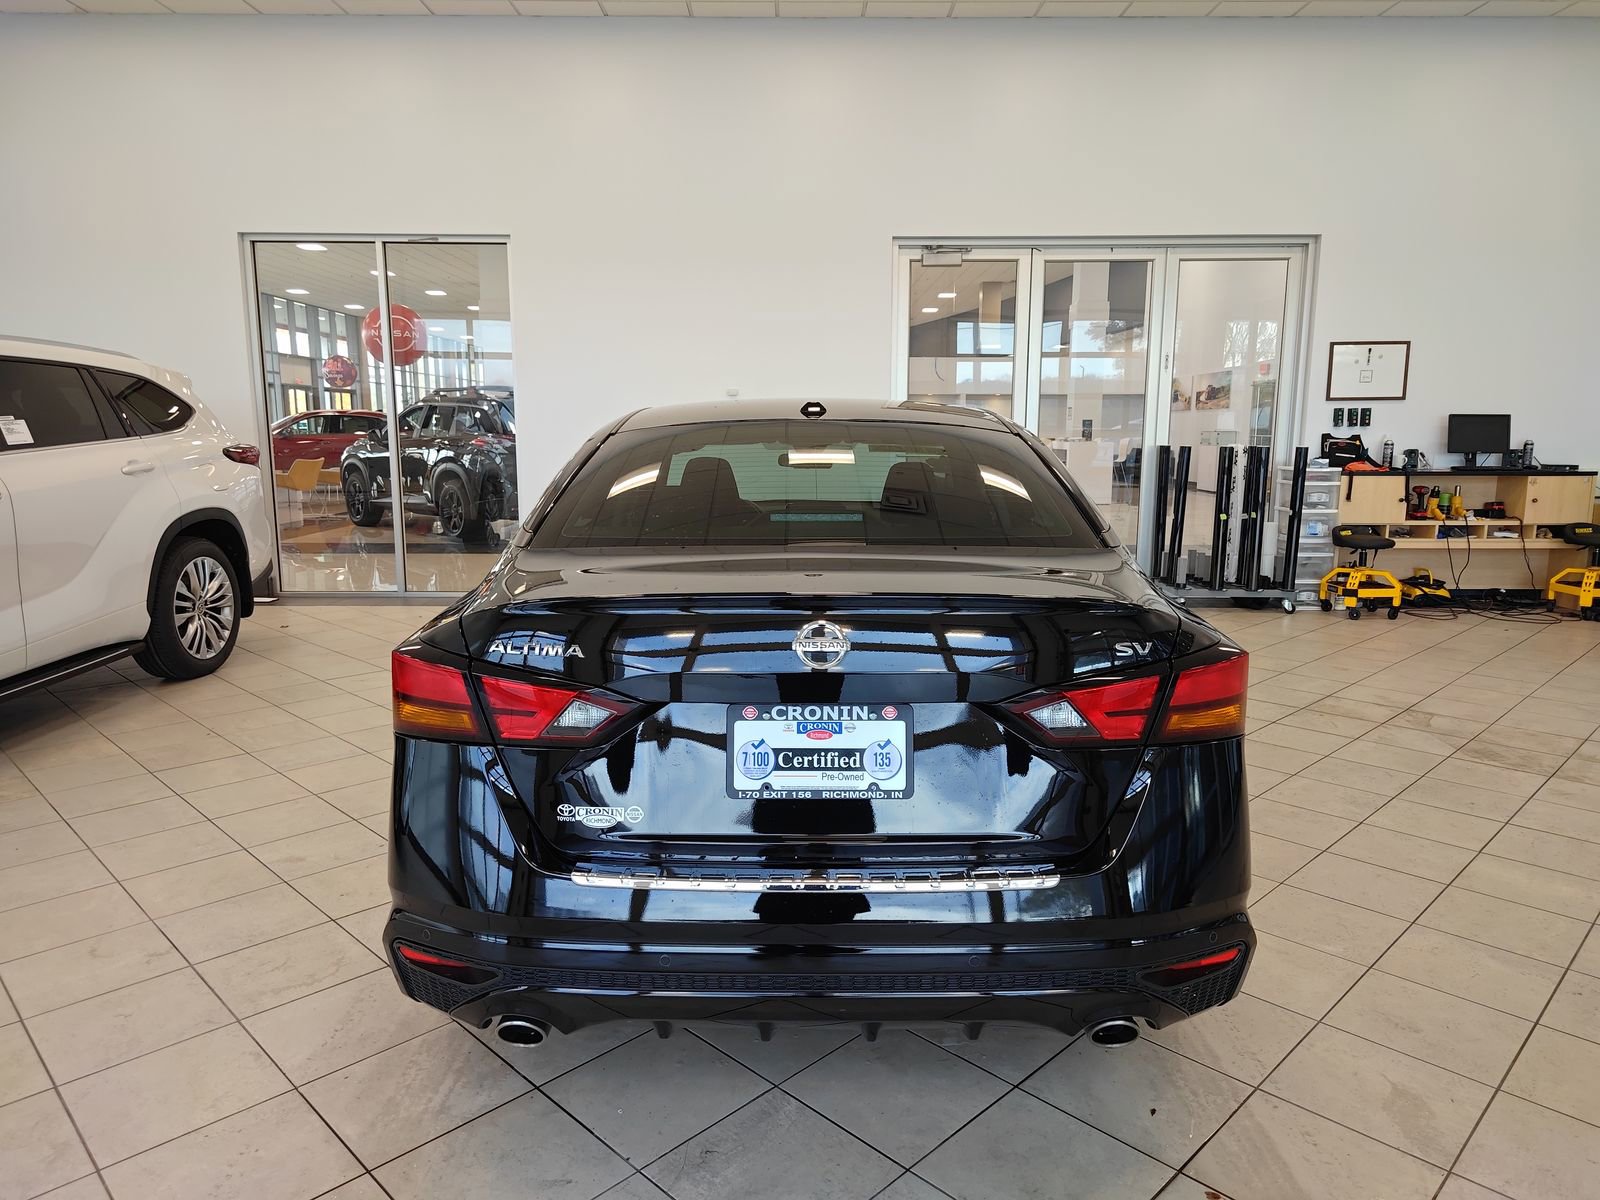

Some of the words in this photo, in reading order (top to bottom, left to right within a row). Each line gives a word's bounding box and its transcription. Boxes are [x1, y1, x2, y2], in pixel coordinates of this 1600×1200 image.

[371, 329, 420, 338] NSAN
[489, 639, 585, 658] ALTIMA
[798, 641, 845, 649] NISSAN
[1115, 642, 1153, 657] SV
[771, 705, 868, 721] CRONIN
[799, 722, 840, 733] CRONIN
[778, 752, 861, 768] Certified
[873, 752, 891, 767] 135
[821, 772, 865, 782] Pre-Owned
[738, 791, 760, 799] I-70
[763, 791, 789, 799] EXIT
[791, 791, 812, 799] 156
[890, 791, 903, 799] IN
[576, 807, 623, 819] CRONIN
[585, 816, 614, 824] RICHMOND
